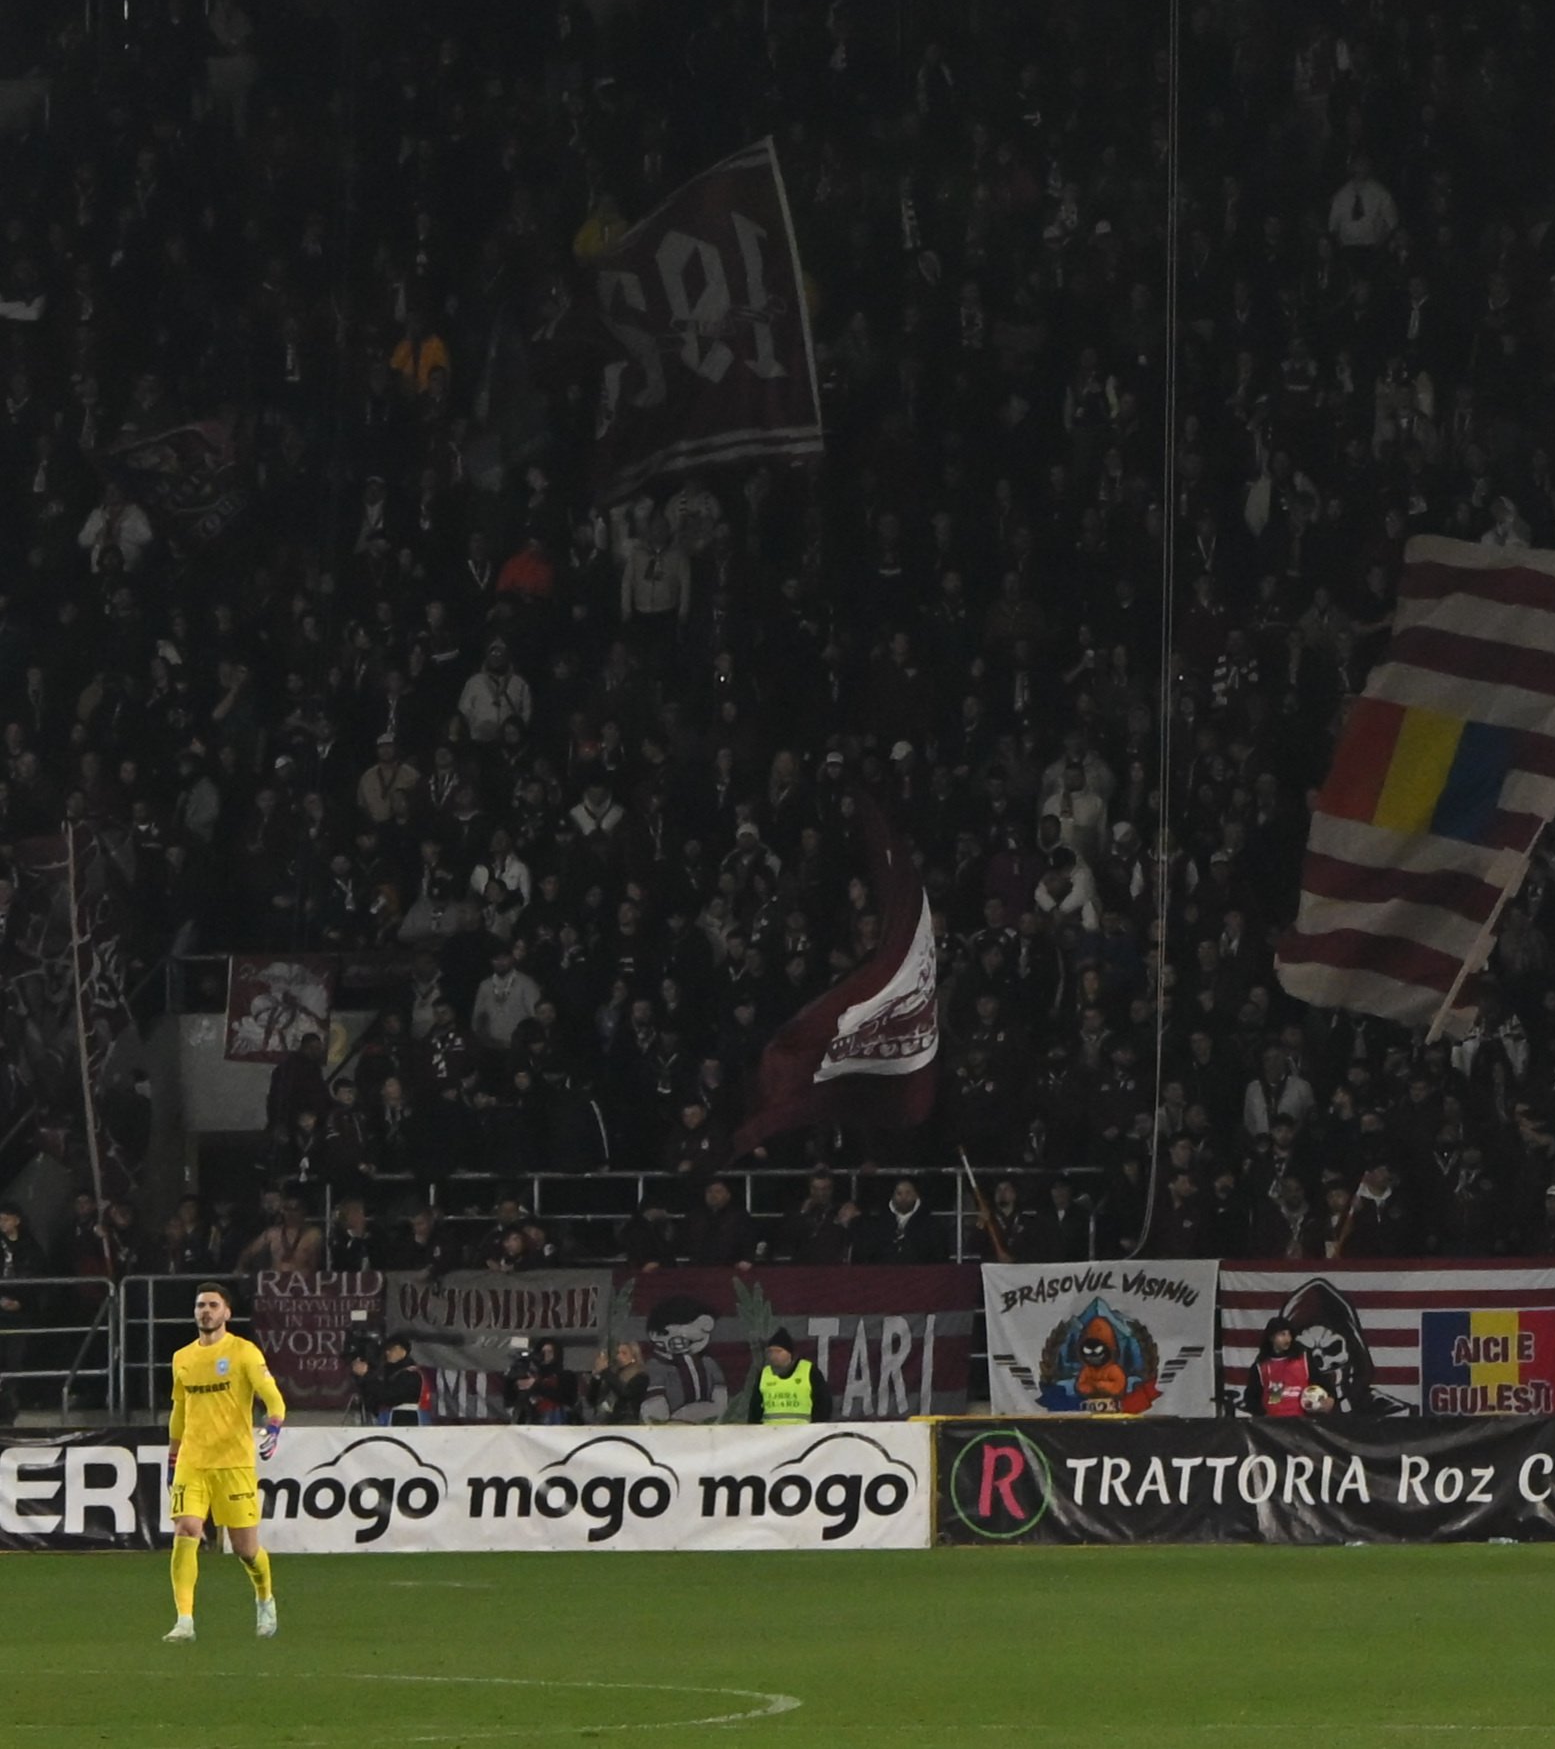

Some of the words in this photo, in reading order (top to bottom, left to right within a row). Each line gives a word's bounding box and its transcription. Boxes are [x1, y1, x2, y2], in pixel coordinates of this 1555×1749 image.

[255, 1270, 384, 1297] RAPID
[254, 1298, 381, 1313] EVERYWHERE
[285, 1314, 303, 1328] IN
[398, 1282, 599, 1331] OCTOMBRIE
[255, 1330, 346, 1356] WOR
[1451, 1335, 1511, 1366] AICI
[1516, 1331, 1535, 1363] E
[297, 1356, 339, 1373] 1923
[807, 1313, 937, 1418] TARI
[1065, 1454, 1371, 1506] TRATTORIA
[1396, 1458, 1495, 1506] Roz
[468, 1471, 671, 1542] mogo
[700, 1471, 908, 1541] mogo
